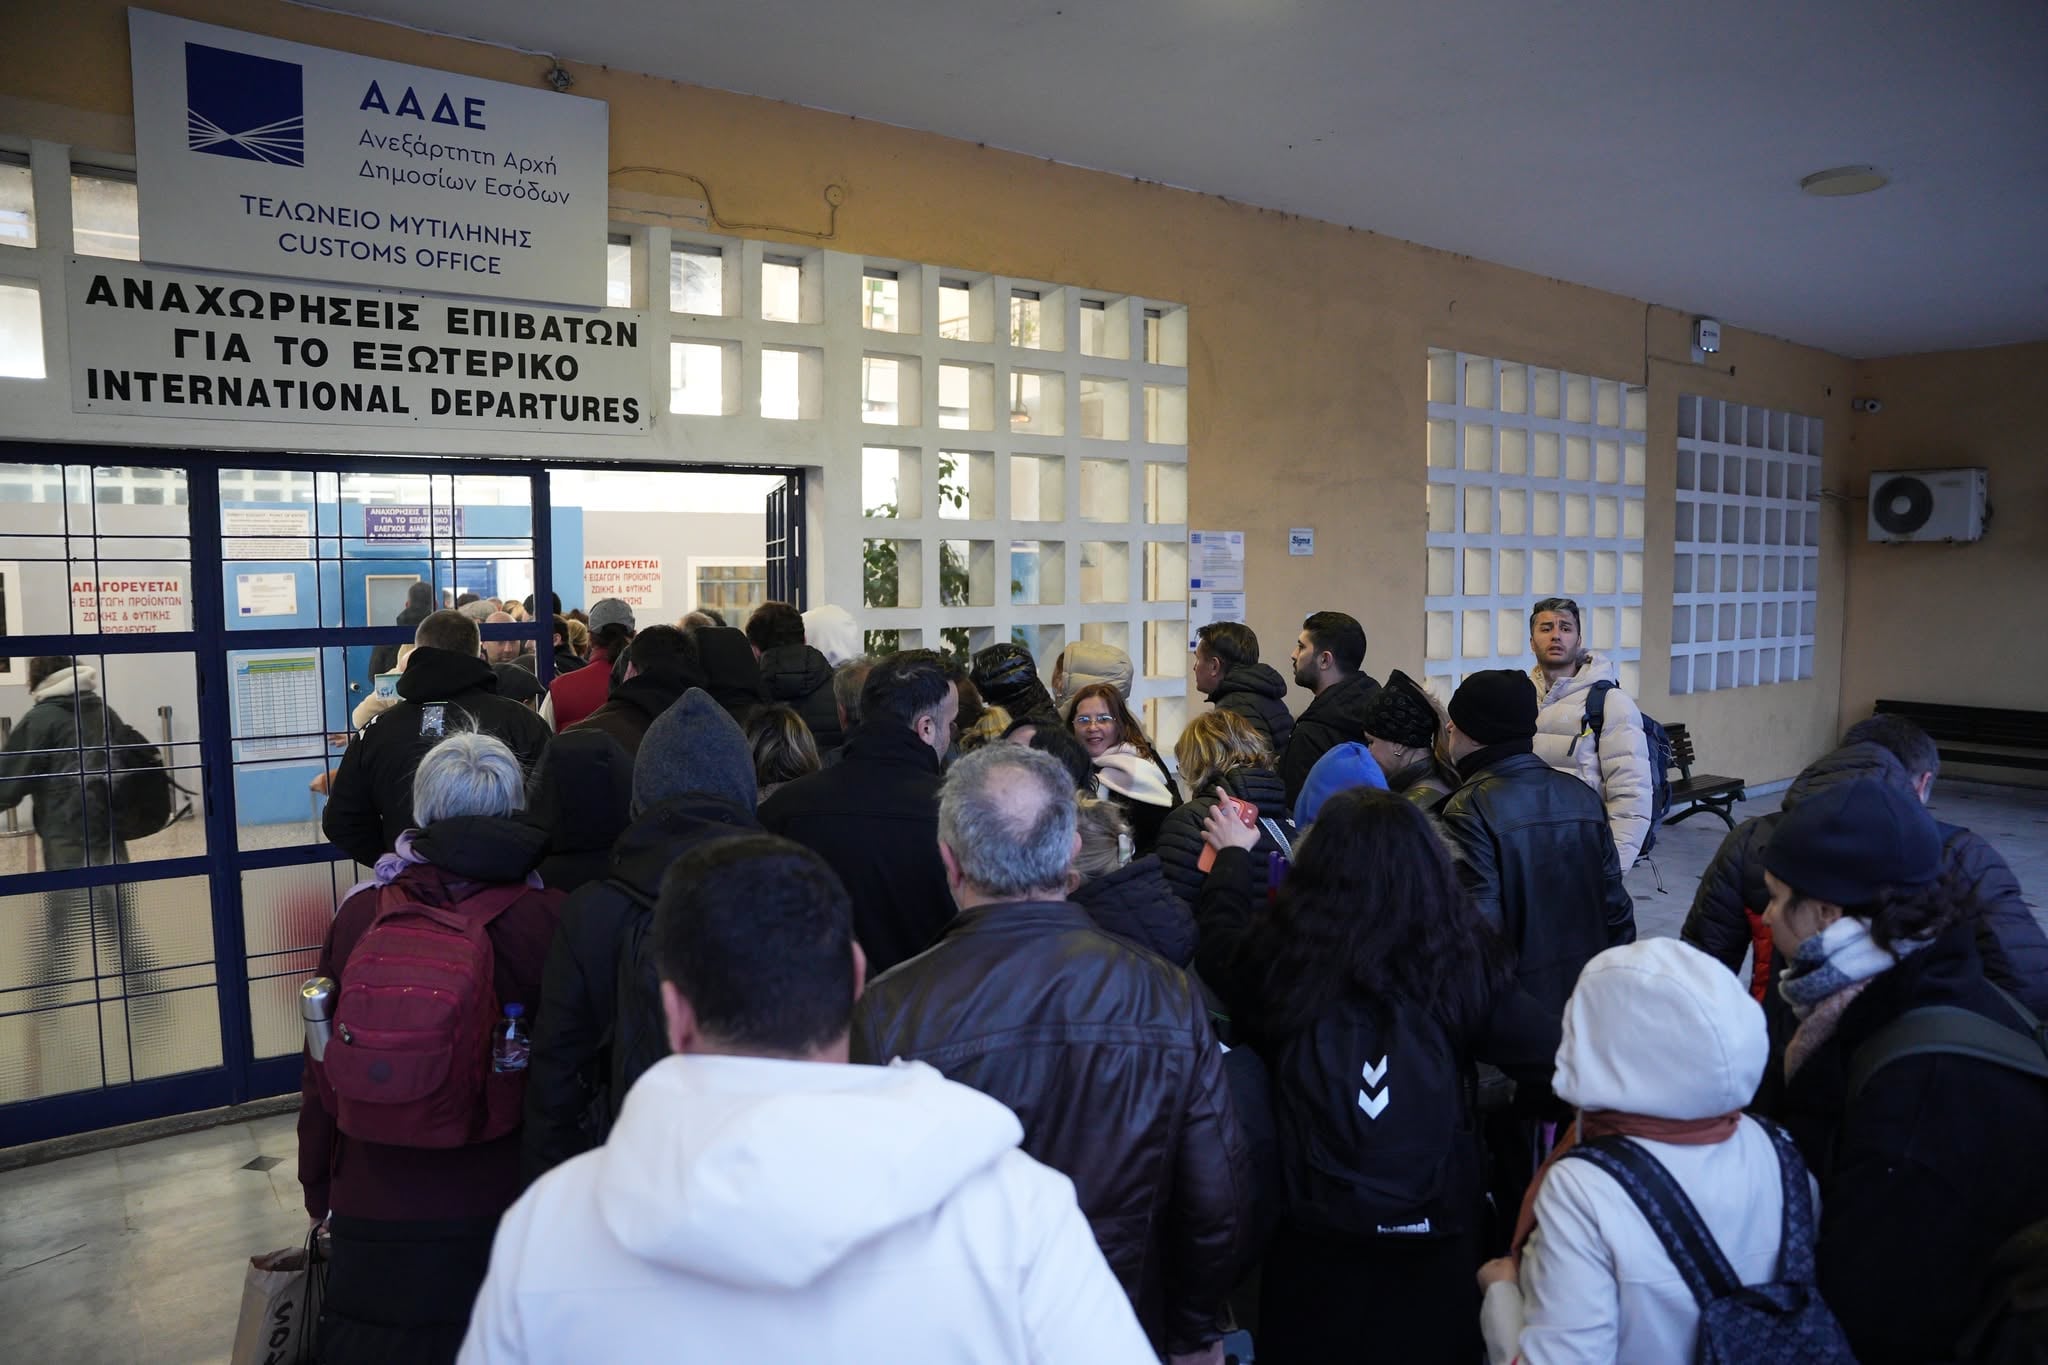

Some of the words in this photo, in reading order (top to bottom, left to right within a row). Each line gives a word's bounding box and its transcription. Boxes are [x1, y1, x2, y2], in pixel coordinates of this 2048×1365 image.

[359, 79, 486, 131] ΑΑΔΕ
[359, 129, 495, 167] Ανεξάρτητη
[503, 150, 557, 177] Αρχή
[359, 159, 477, 193] Δημοσίων
[485, 178, 570, 206] Εσόδων
[240, 195, 380, 231] ΤΕΛΩΝΕΙΟ
[390, 214, 532, 249] ΜΥΤΙΛΗΝΗΣ
[278, 233, 407, 265] CUSTOMS
[415, 248, 501, 275] OFFICE
[86, 275, 420, 331] ΑΝΑΧΩΡΗΣΕΙΣ
[446, 307, 638, 348] ΕΠΙΒΑΤΩΝ
[174, 329, 251, 363] ΓΙΑ
[274, 336, 329, 368] ΤΟ
[353, 342, 579, 382] ΕΞΩΤΕΡΙΚΟ
[88, 368, 410, 414] INTERNATIONAL
[431, 388, 640, 425] DEPARTURES
[585, 560, 658, 569] ΑΠΑΓΟΡΕΥΕΤΑΙ
[79, 597, 124, 607] ΕΙΣΓΩΓΗ
[132, 611, 171, 621] ΦΥΤΙΚΗΣ
